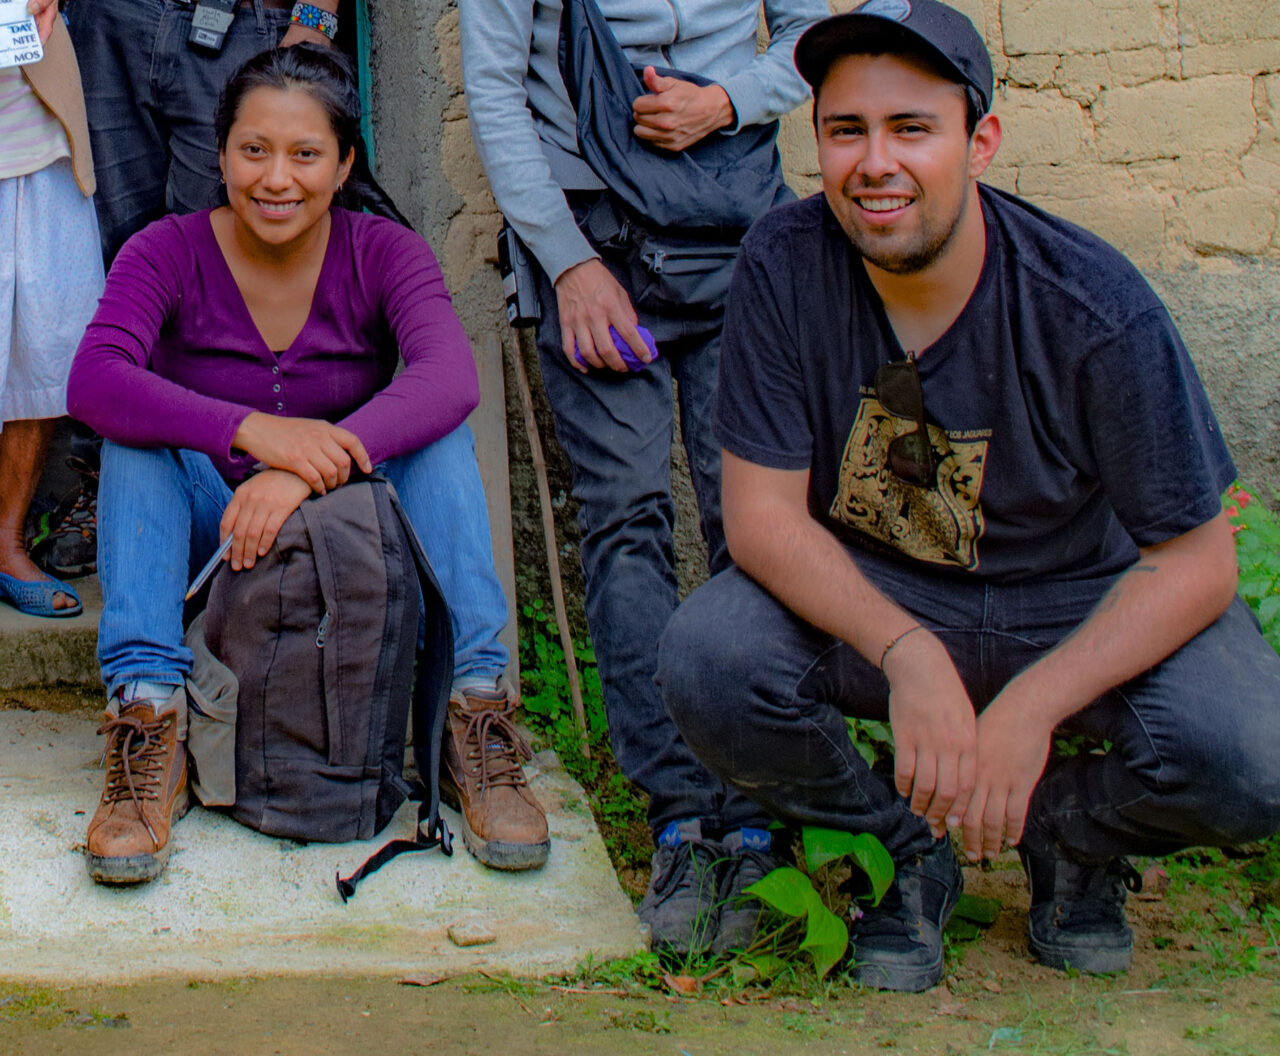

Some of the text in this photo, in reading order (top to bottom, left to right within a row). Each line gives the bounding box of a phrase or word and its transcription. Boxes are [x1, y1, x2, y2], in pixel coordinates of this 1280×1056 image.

[9, 23, 32, 33] DAY
[12, 34, 36, 45] NITE
[14, 50, 40, 63] MOS
